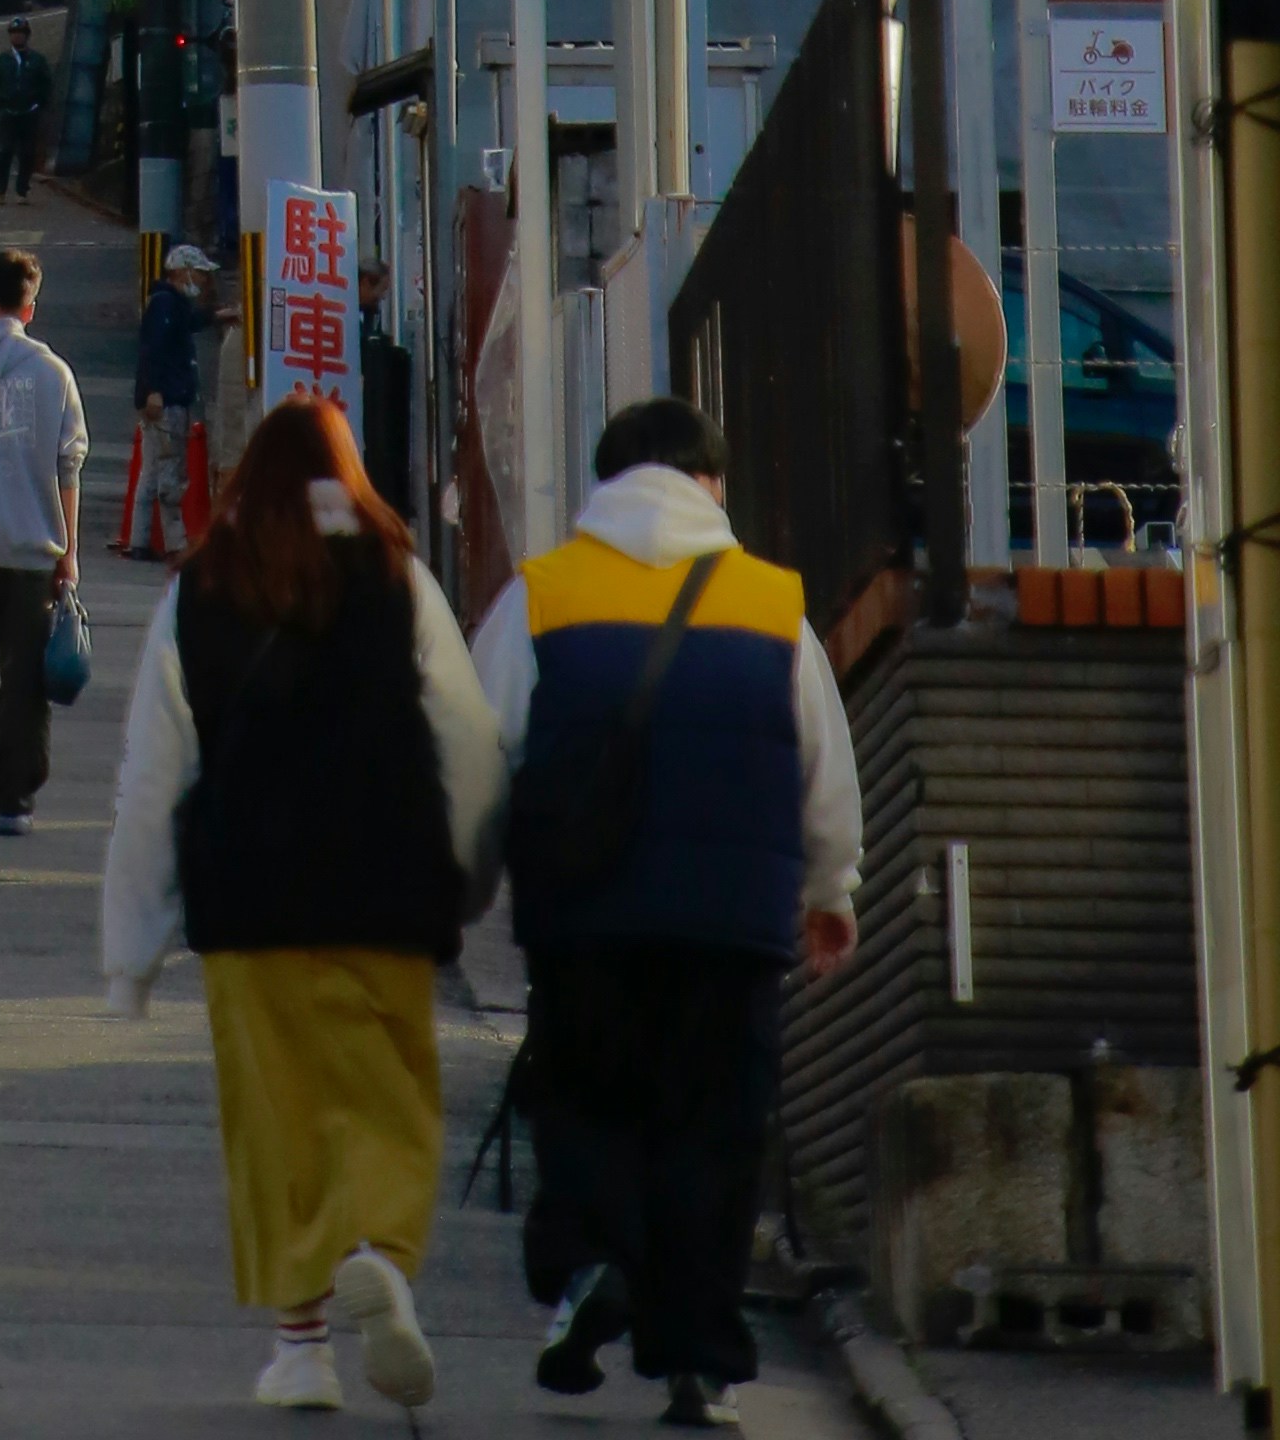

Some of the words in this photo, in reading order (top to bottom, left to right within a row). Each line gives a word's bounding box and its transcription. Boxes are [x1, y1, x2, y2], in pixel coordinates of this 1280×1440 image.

[1079, 80, 1135, 95] バイク
[1069, 99, 1149, 117] 駐輪料金
[281, 197, 349, 412] 駐車
